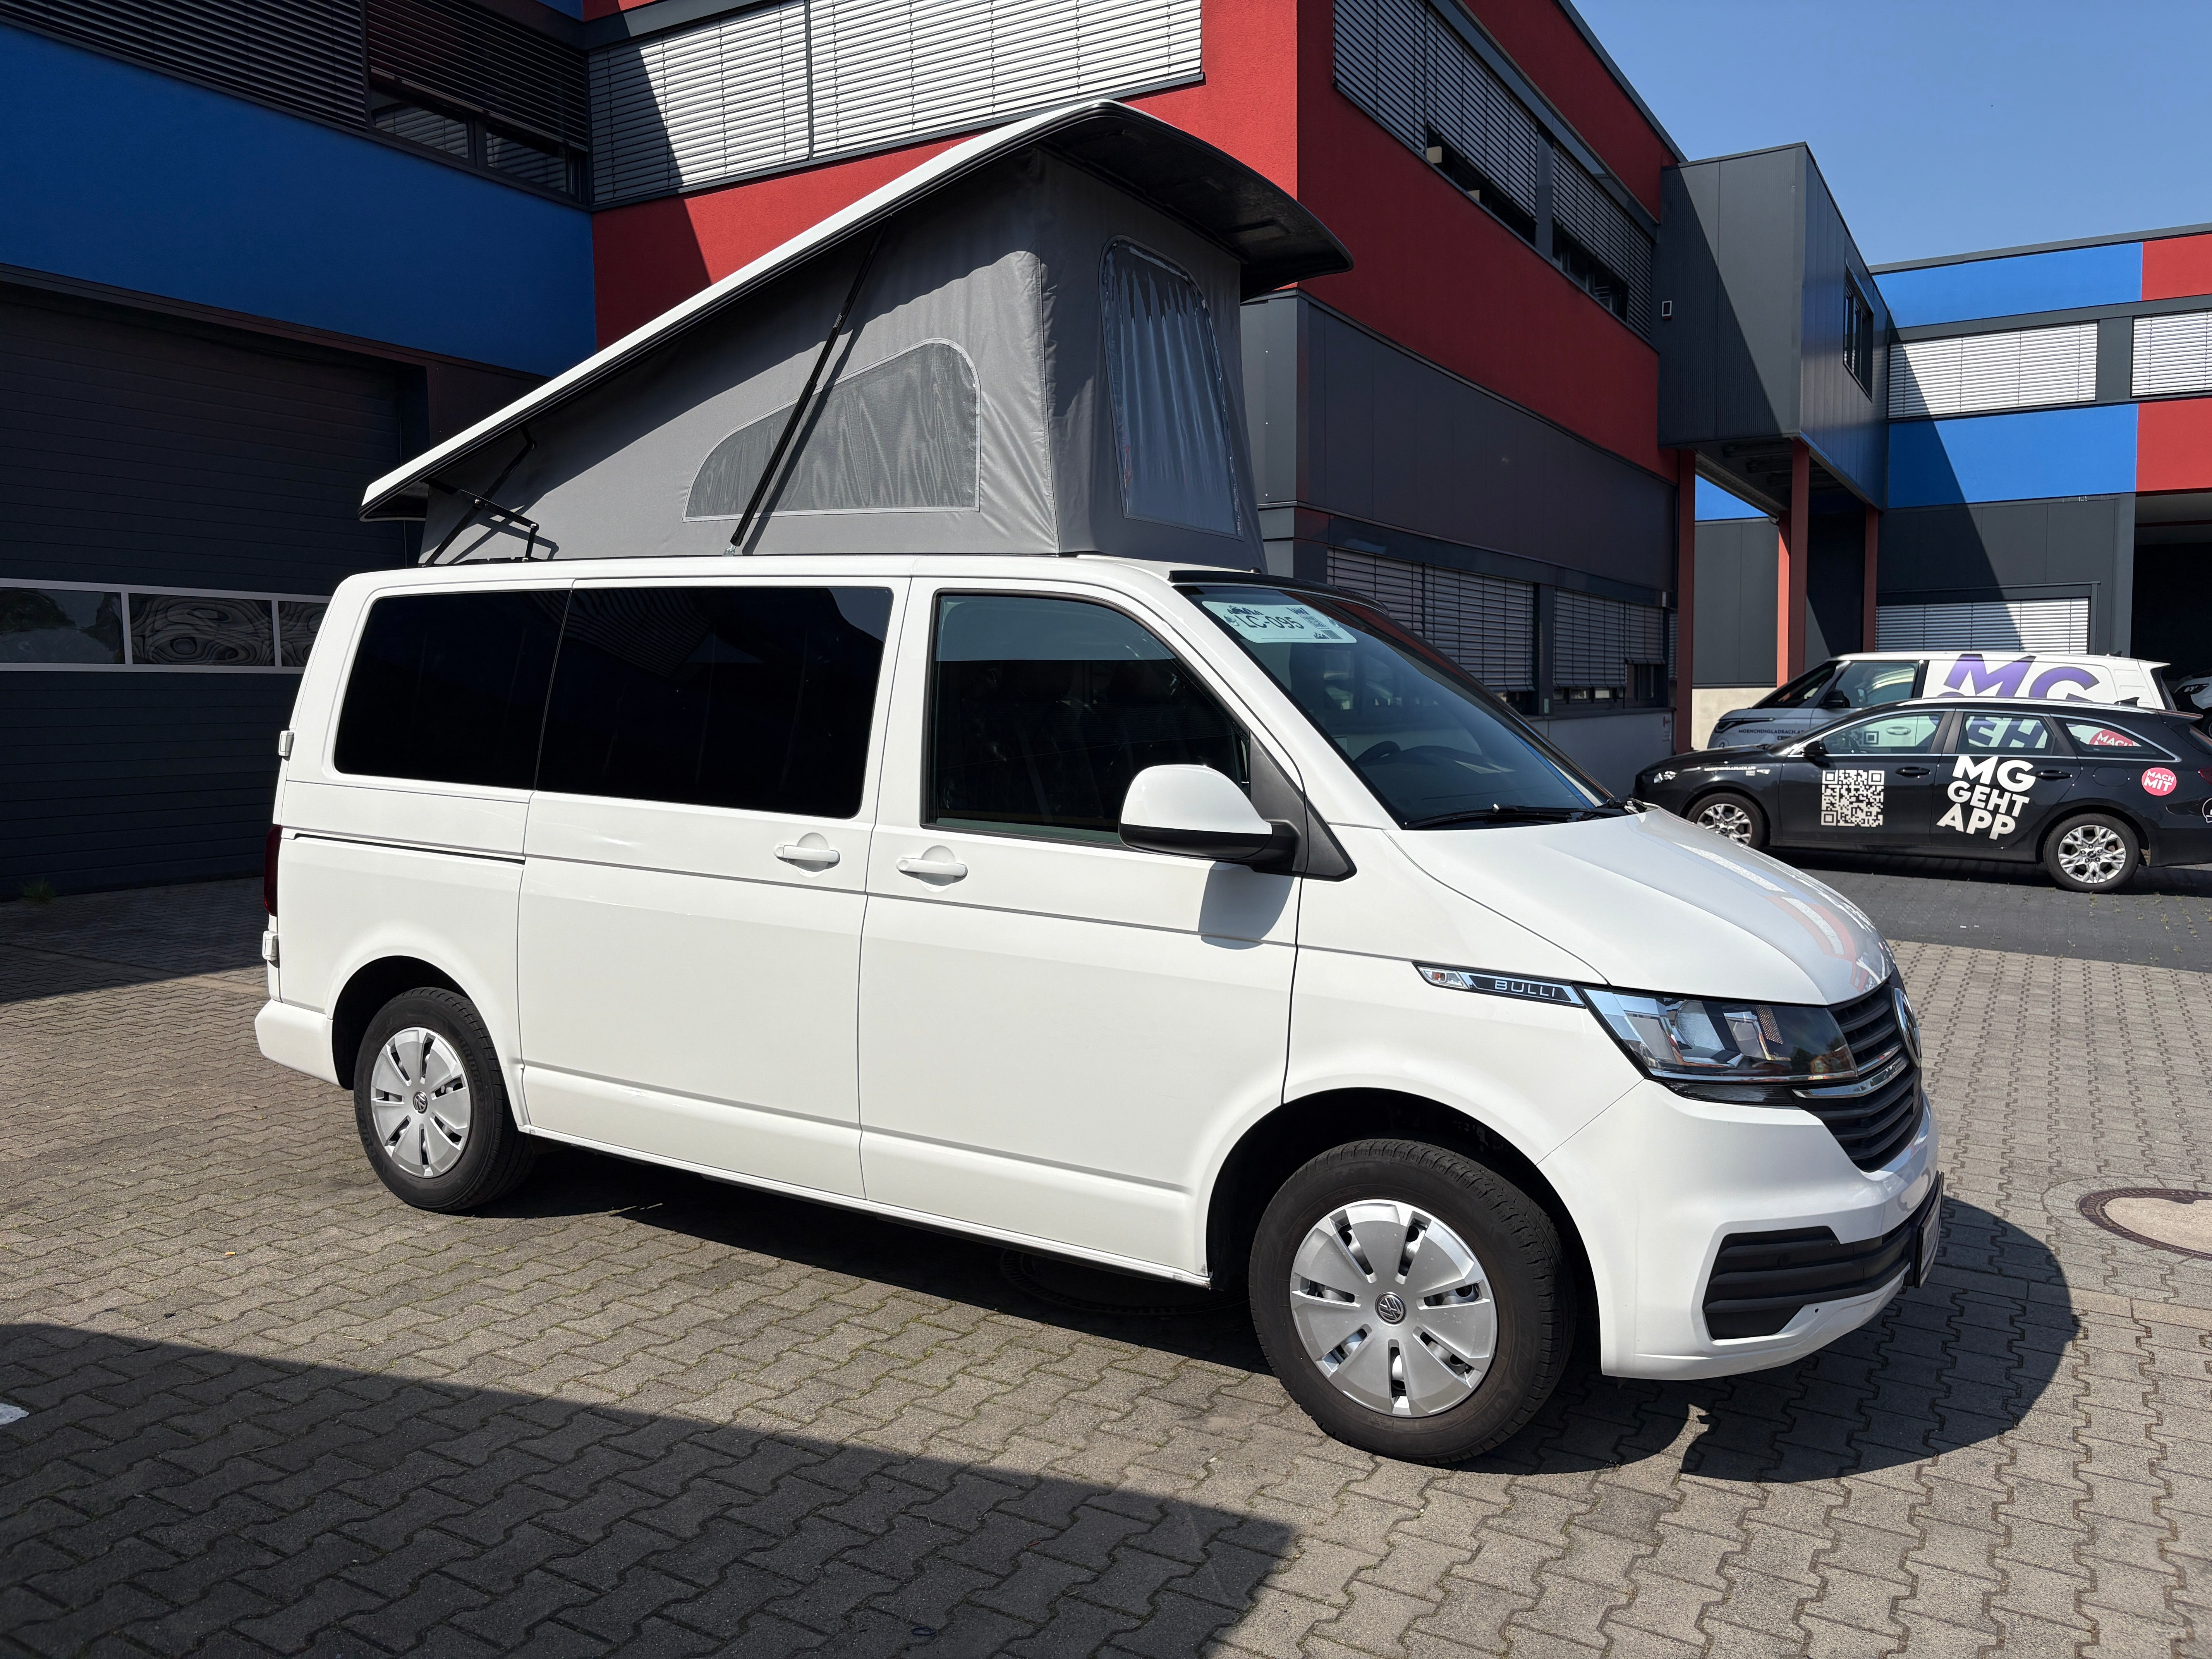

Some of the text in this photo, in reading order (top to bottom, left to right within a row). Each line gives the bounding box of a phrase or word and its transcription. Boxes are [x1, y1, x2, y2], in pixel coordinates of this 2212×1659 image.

[1238, 615, 1304, 629] LC-095
[1943, 653, 2100, 701] MG
[1952, 755, 2036, 792] MG
[2143, 776, 2172, 792] MIT
[2147, 769, 2175, 783] MACH
[1947, 780, 2030, 817] GEHT
[1936, 803, 2016, 840] APP
[1494, 980, 1555, 997] BULLI
